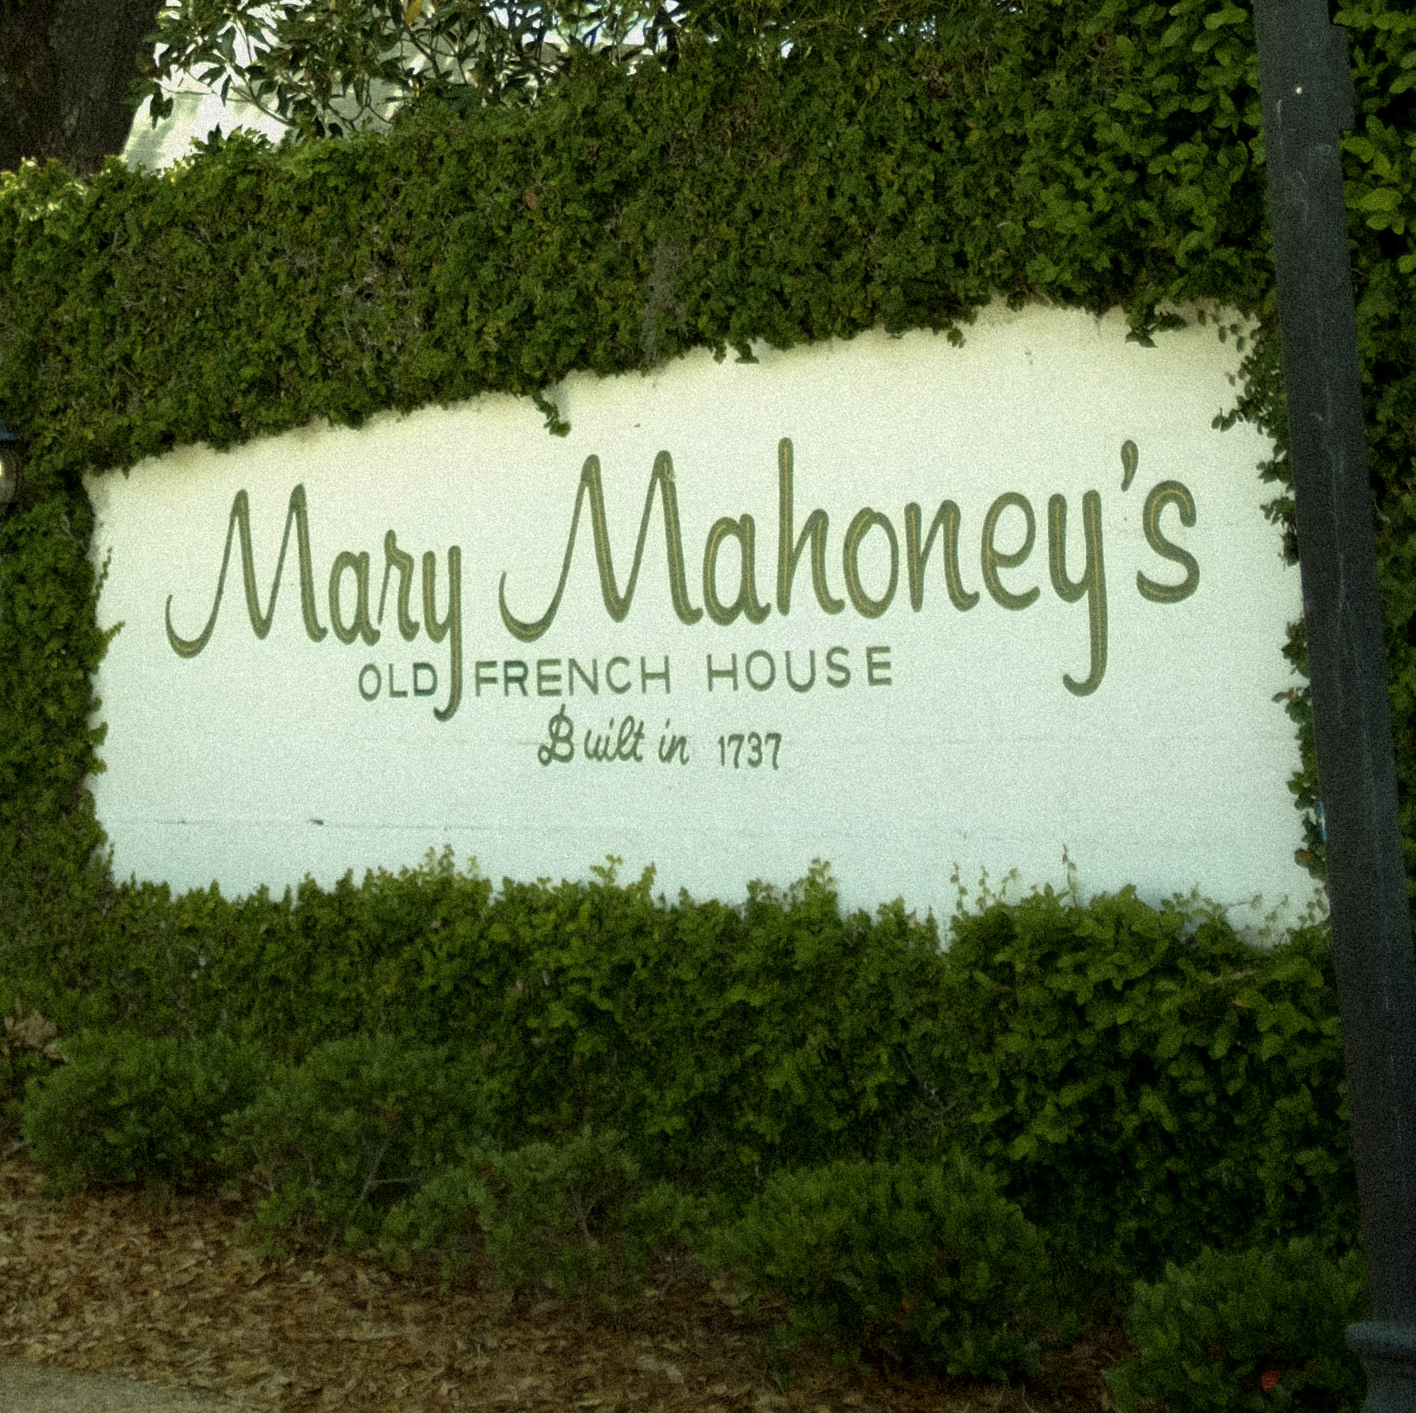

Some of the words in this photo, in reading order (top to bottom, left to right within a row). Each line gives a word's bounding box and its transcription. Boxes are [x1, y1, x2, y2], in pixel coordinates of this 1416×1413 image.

[164, 482, 464, 722] Mary
[498, 436, 1201, 698] Mahoney's
[358, 660, 439, 702] OLD
[474, 654, 672, 698] FRENCH
[706, 645, 892, 694] HOUSE
[537, 704, 645, 767] Built
[658, 718, 690, 766] in
[717, 731, 783, 771] 1737
